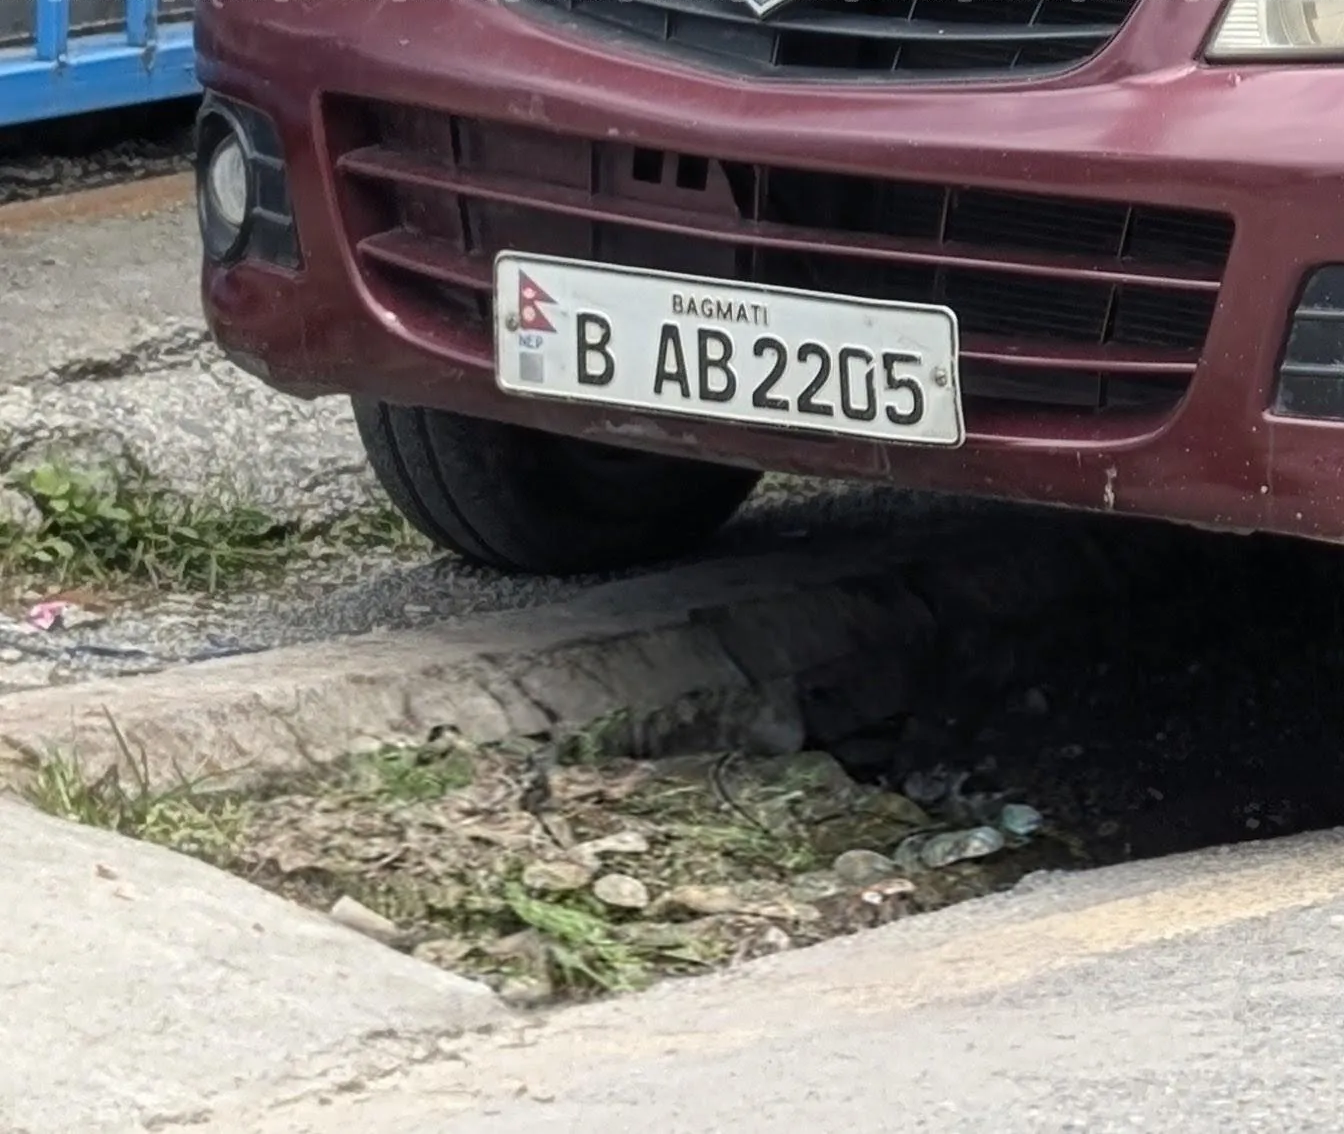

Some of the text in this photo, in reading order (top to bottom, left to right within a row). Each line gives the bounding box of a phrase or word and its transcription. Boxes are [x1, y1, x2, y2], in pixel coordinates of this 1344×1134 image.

[672, 294, 768, 325] BAGMATI
[518, 334, 543, 348] NEP
[576, 312, 615, 386] B
